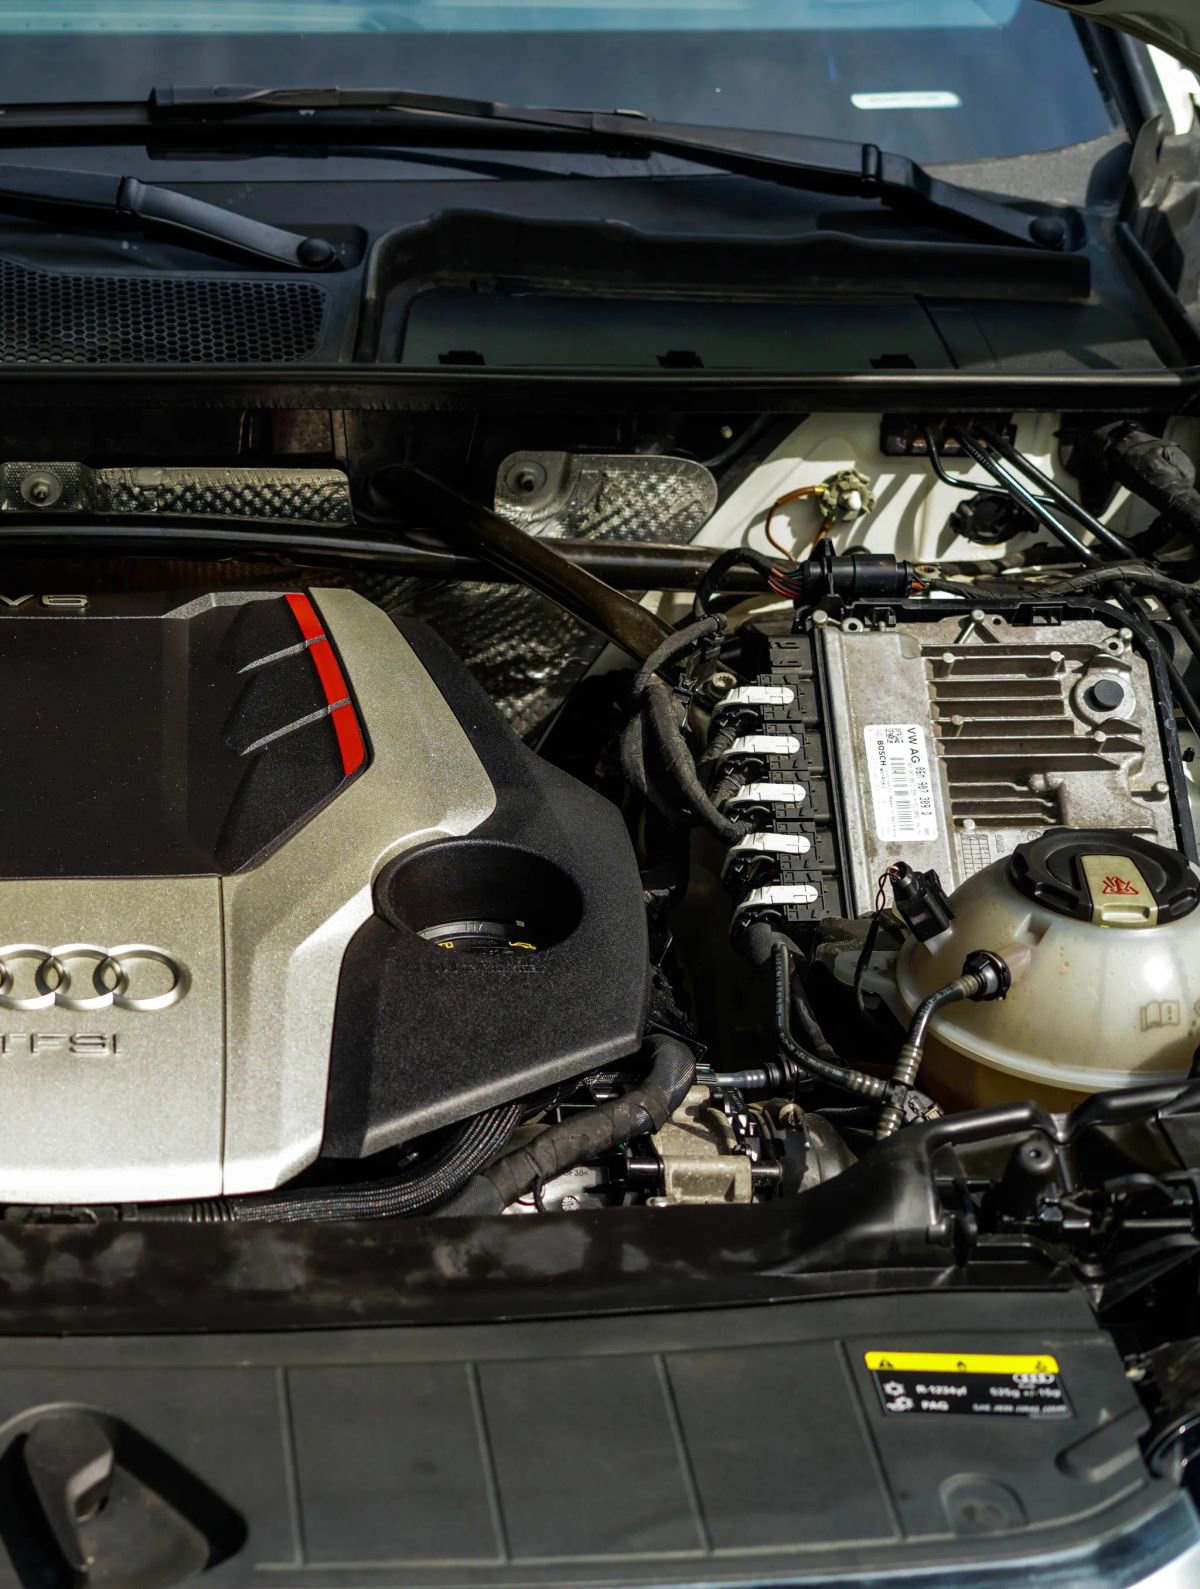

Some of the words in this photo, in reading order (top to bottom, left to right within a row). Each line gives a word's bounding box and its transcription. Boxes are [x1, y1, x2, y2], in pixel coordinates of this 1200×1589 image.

[907, 727, 918, 745] VW
[877, 740, 887, 766] BOSCH
[910, 747, 921, 764] AG
[919, 796, 932, 808] 309
